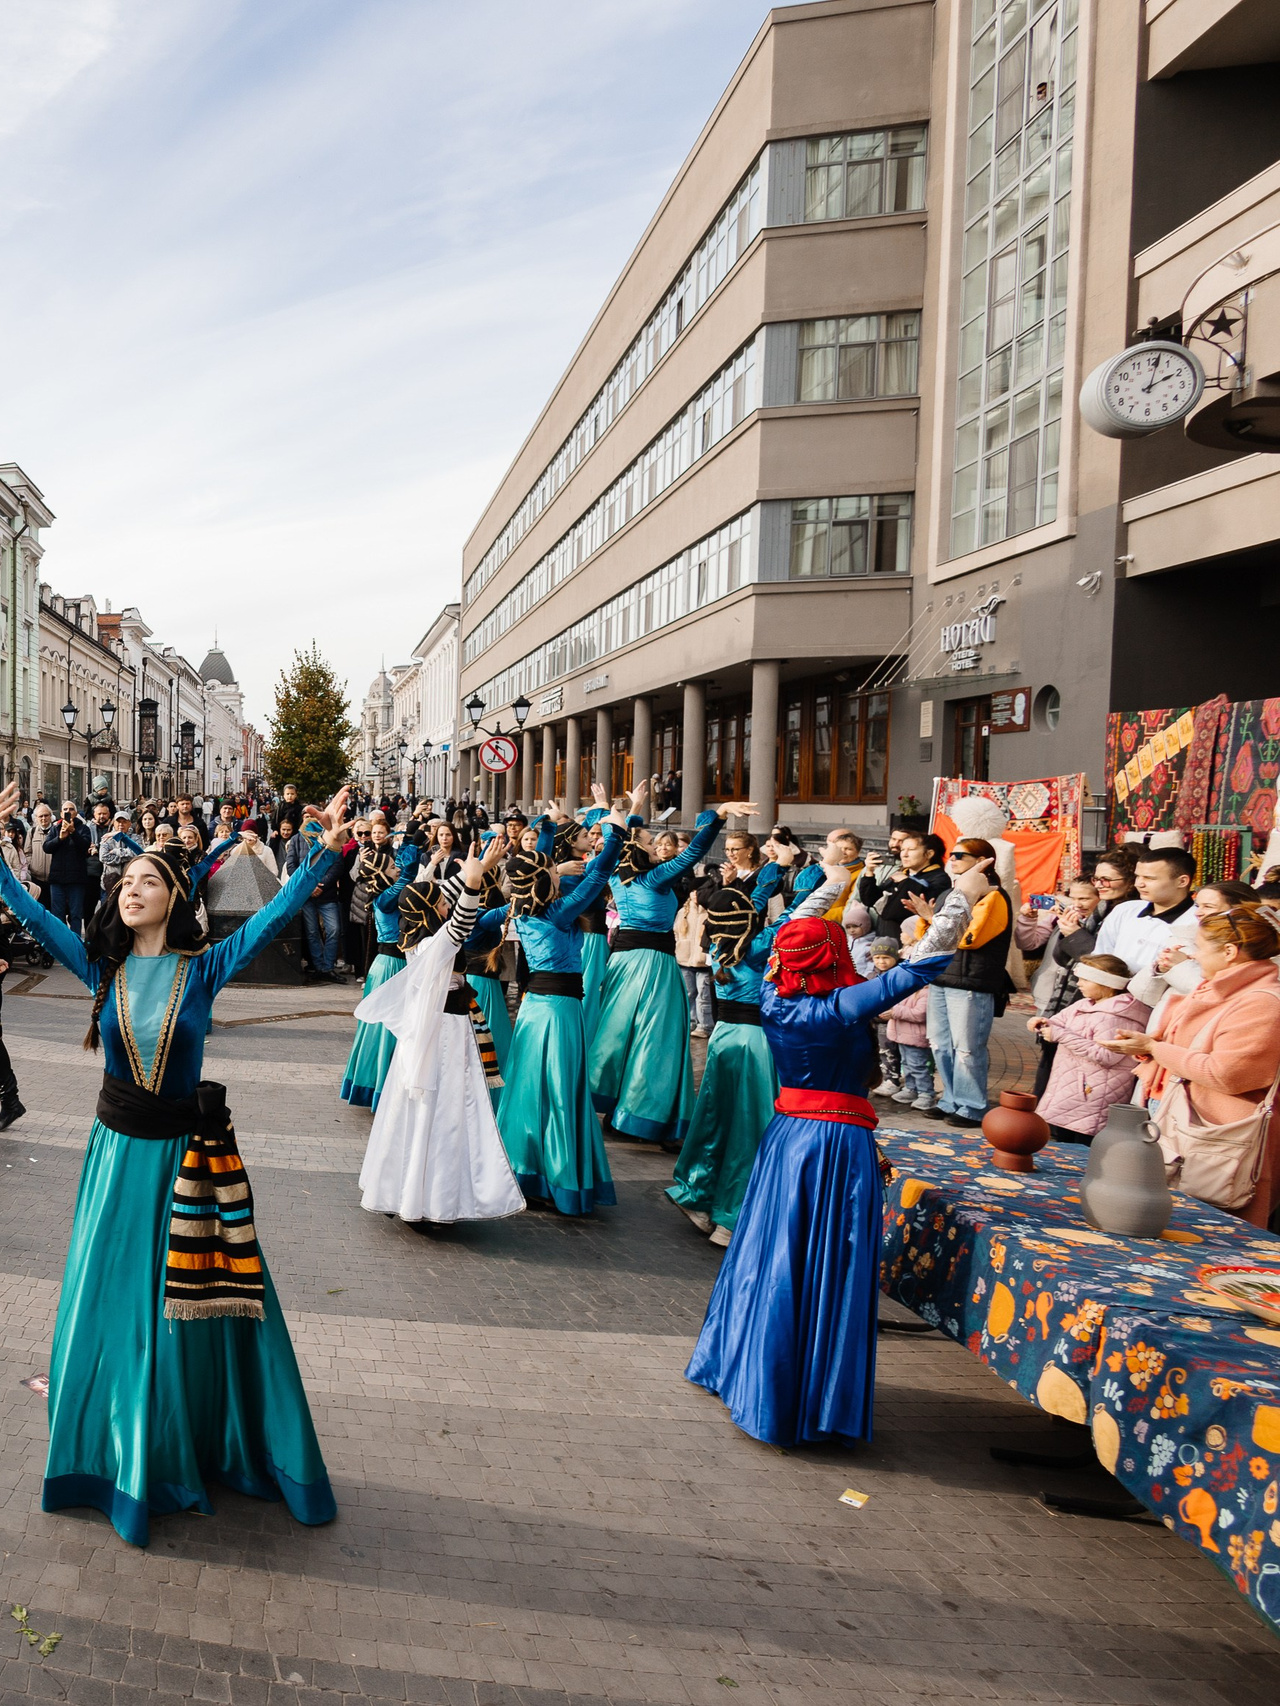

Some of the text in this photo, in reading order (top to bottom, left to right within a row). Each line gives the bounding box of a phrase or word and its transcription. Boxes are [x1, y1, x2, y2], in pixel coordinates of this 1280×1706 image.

[1132, 362, 1141, 370] 11
[1146, 358, 1157, 366] 12
[1165, 360, 1170, 368] 1
[1118, 372, 1129, 381] 10
[1176, 368, 1182, 377] 2
[1114, 385, 1120, 393] 9
[1179, 381, 1185, 389] 3
[1118, 398, 1124, 406] 8
[1162, 403, 1168, 411] 5
[1144, 408, 1150, 416] 6
